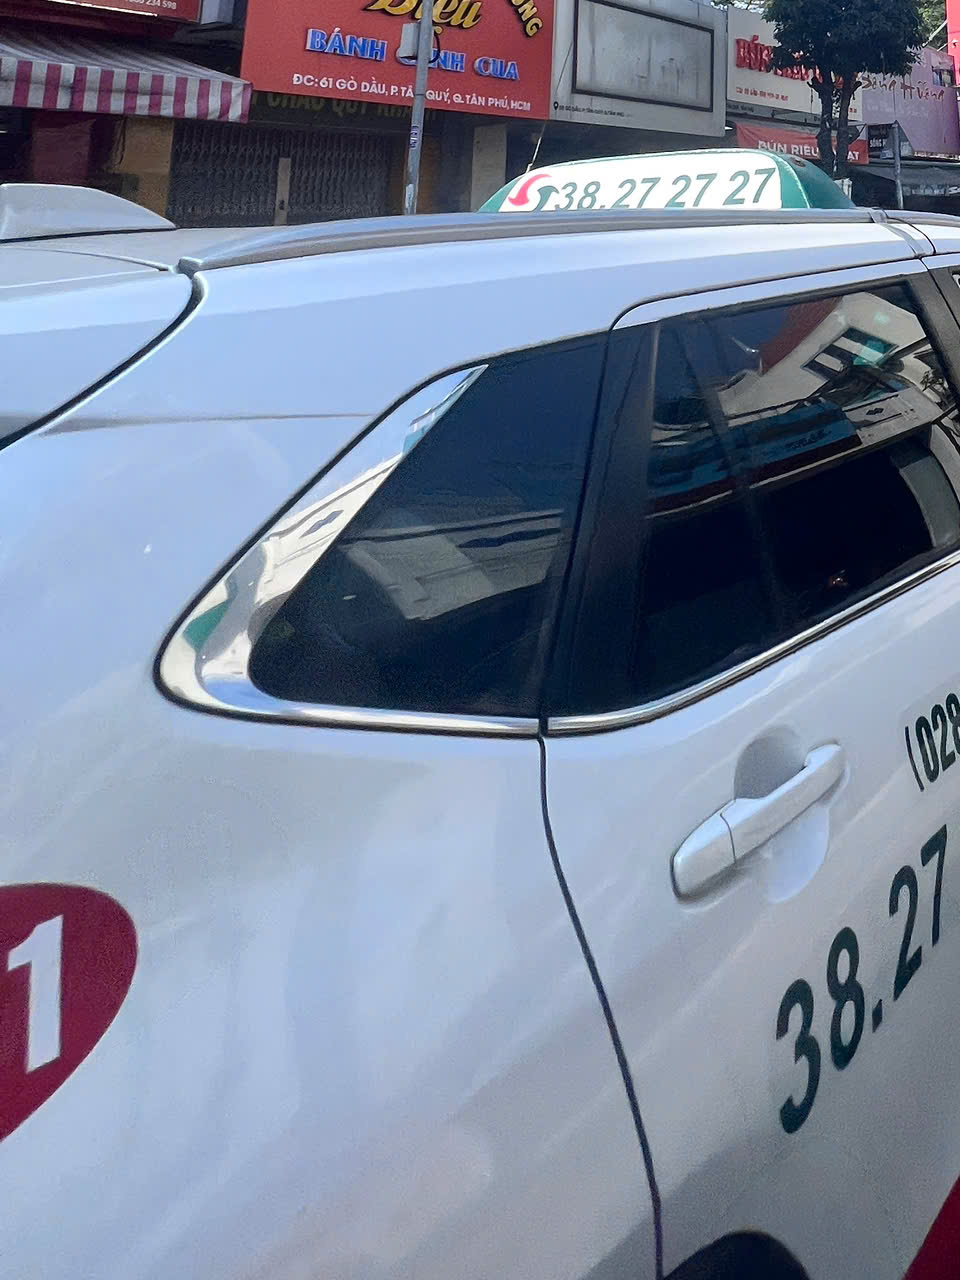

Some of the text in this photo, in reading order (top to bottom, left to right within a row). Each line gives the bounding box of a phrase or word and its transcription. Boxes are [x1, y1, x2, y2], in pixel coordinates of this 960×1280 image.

[305, 27, 388, 62] BÁNH
[474, 56, 520, 81] CUA
[335, 75, 357, 91] GÒ
[360, 76, 389, 96] DẦU,
[757, 139, 787, 154] BÚN
[553, 167, 776, 210] 38.27 27 27
[775, 823, 948, 1134] 38.27
